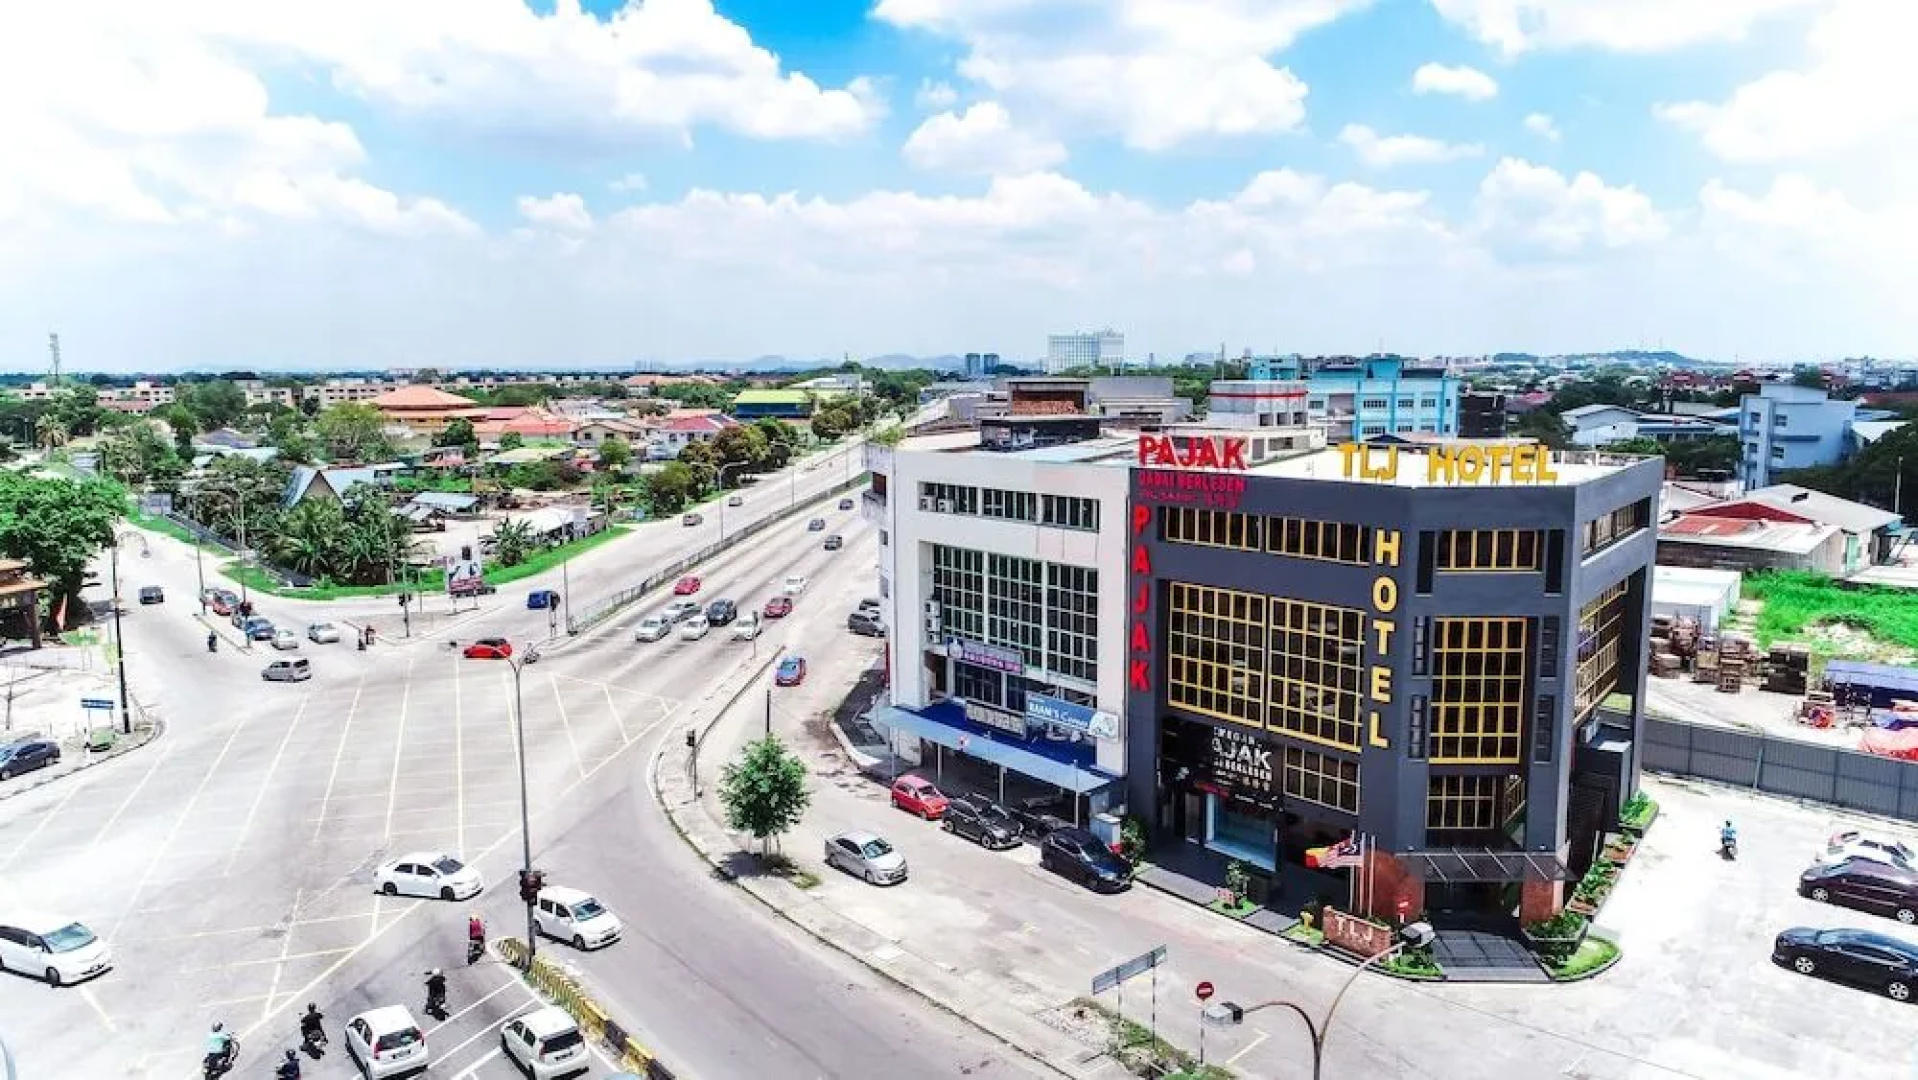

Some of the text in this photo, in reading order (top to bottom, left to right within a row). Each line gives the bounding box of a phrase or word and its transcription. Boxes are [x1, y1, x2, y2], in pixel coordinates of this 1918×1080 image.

[1138, 435, 1246, 469] PAJAK
[1338, 443, 1558, 482] TLJ HOTEL
[1130, 505, 1151, 692] PAJAK
[1369, 529, 1400, 749] HOTEL
[1336, 919, 1373, 941] TLJ
